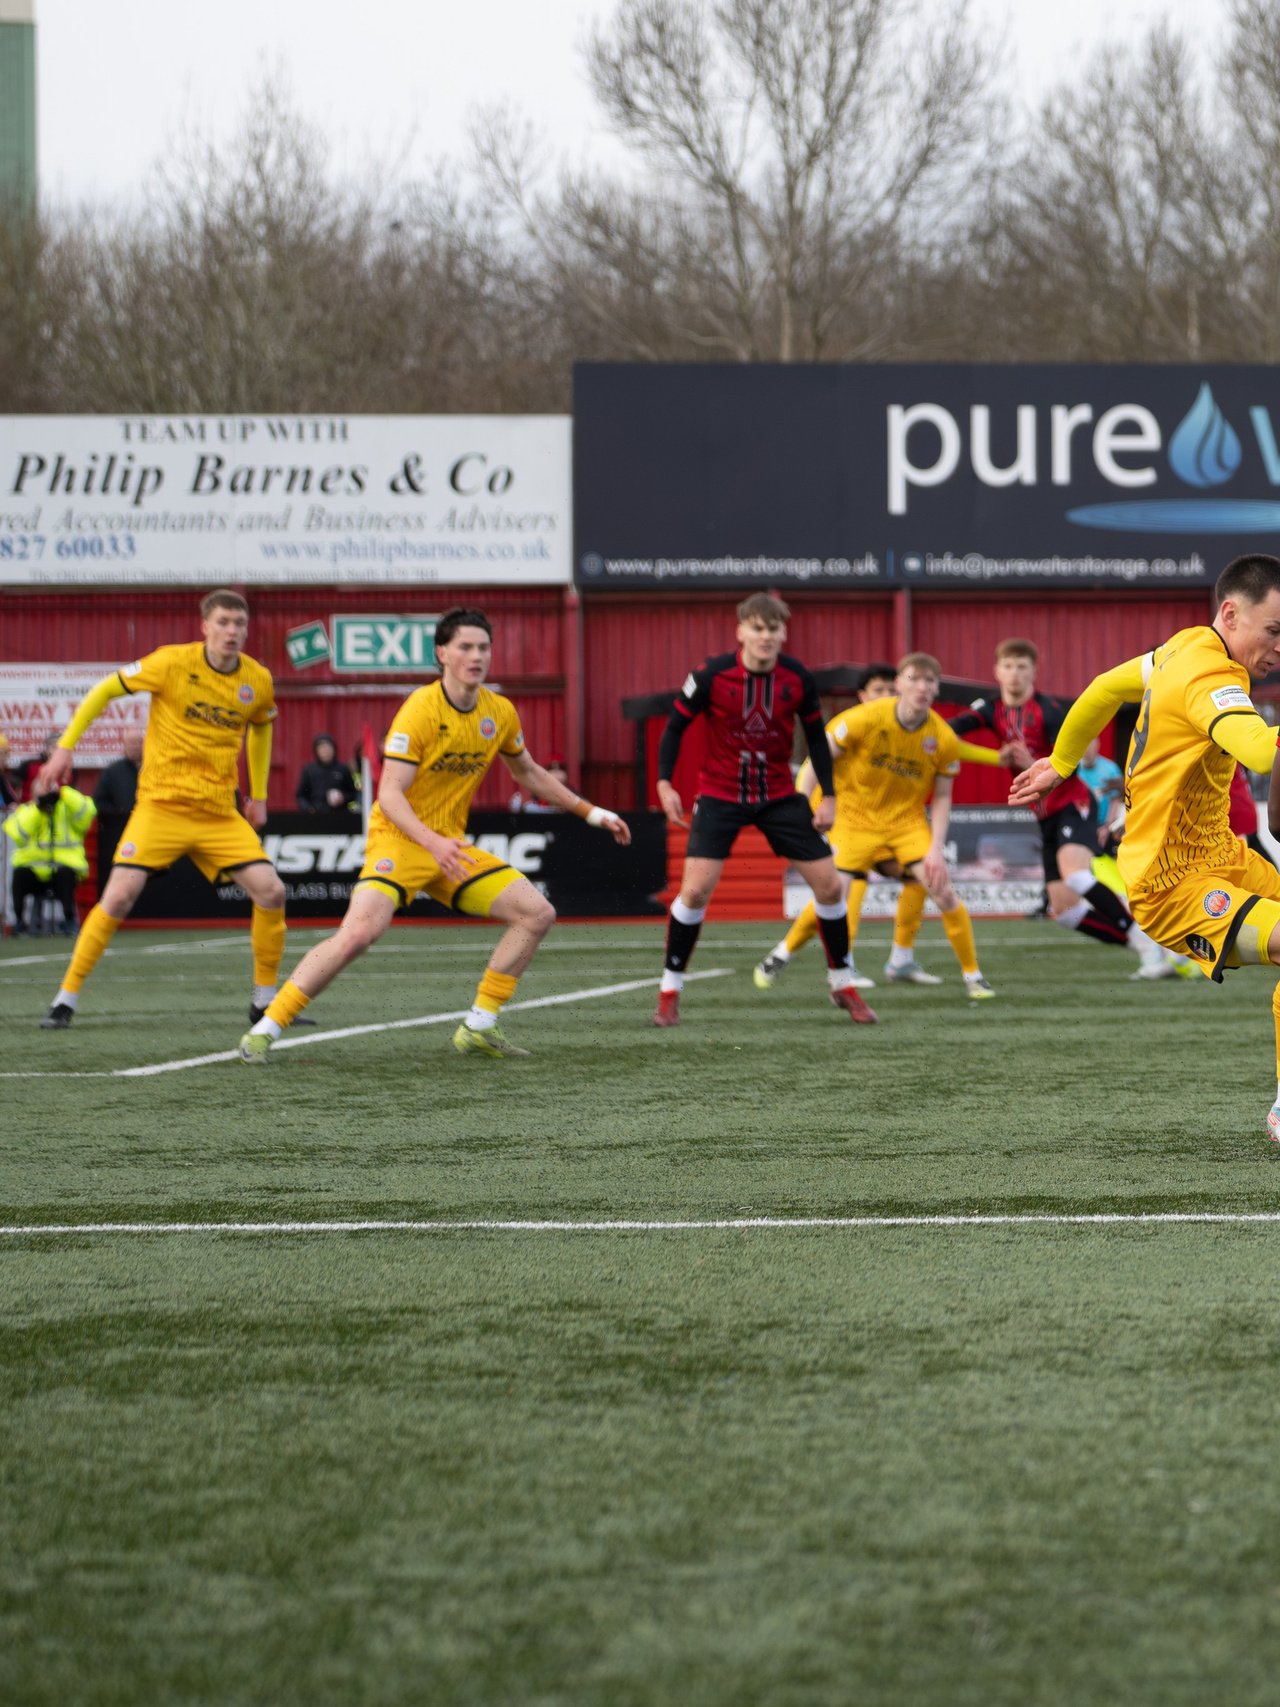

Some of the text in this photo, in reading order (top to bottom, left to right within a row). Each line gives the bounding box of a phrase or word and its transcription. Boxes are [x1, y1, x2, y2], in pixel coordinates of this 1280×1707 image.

[119, 420, 350, 442] TEAM UP WITH
[887, 402, 1162, 515] pure
[11, 451, 516, 505] Philip Barnes & Co
[54, 506, 229, 532] Accountants
[237, 504, 293, 532] and
[304, 504, 426, 533] Business
[436, 504, 558, 533] Advisers
[0, 534, 137, 560] 827 60033
[259, 535, 551, 565] www.philipbarnes.co.uk
[604, 551, 880, 580] www.purewaterstorage.co.uk
[925, 551, 1205, 580] info@purewaterstorage.co.uk
